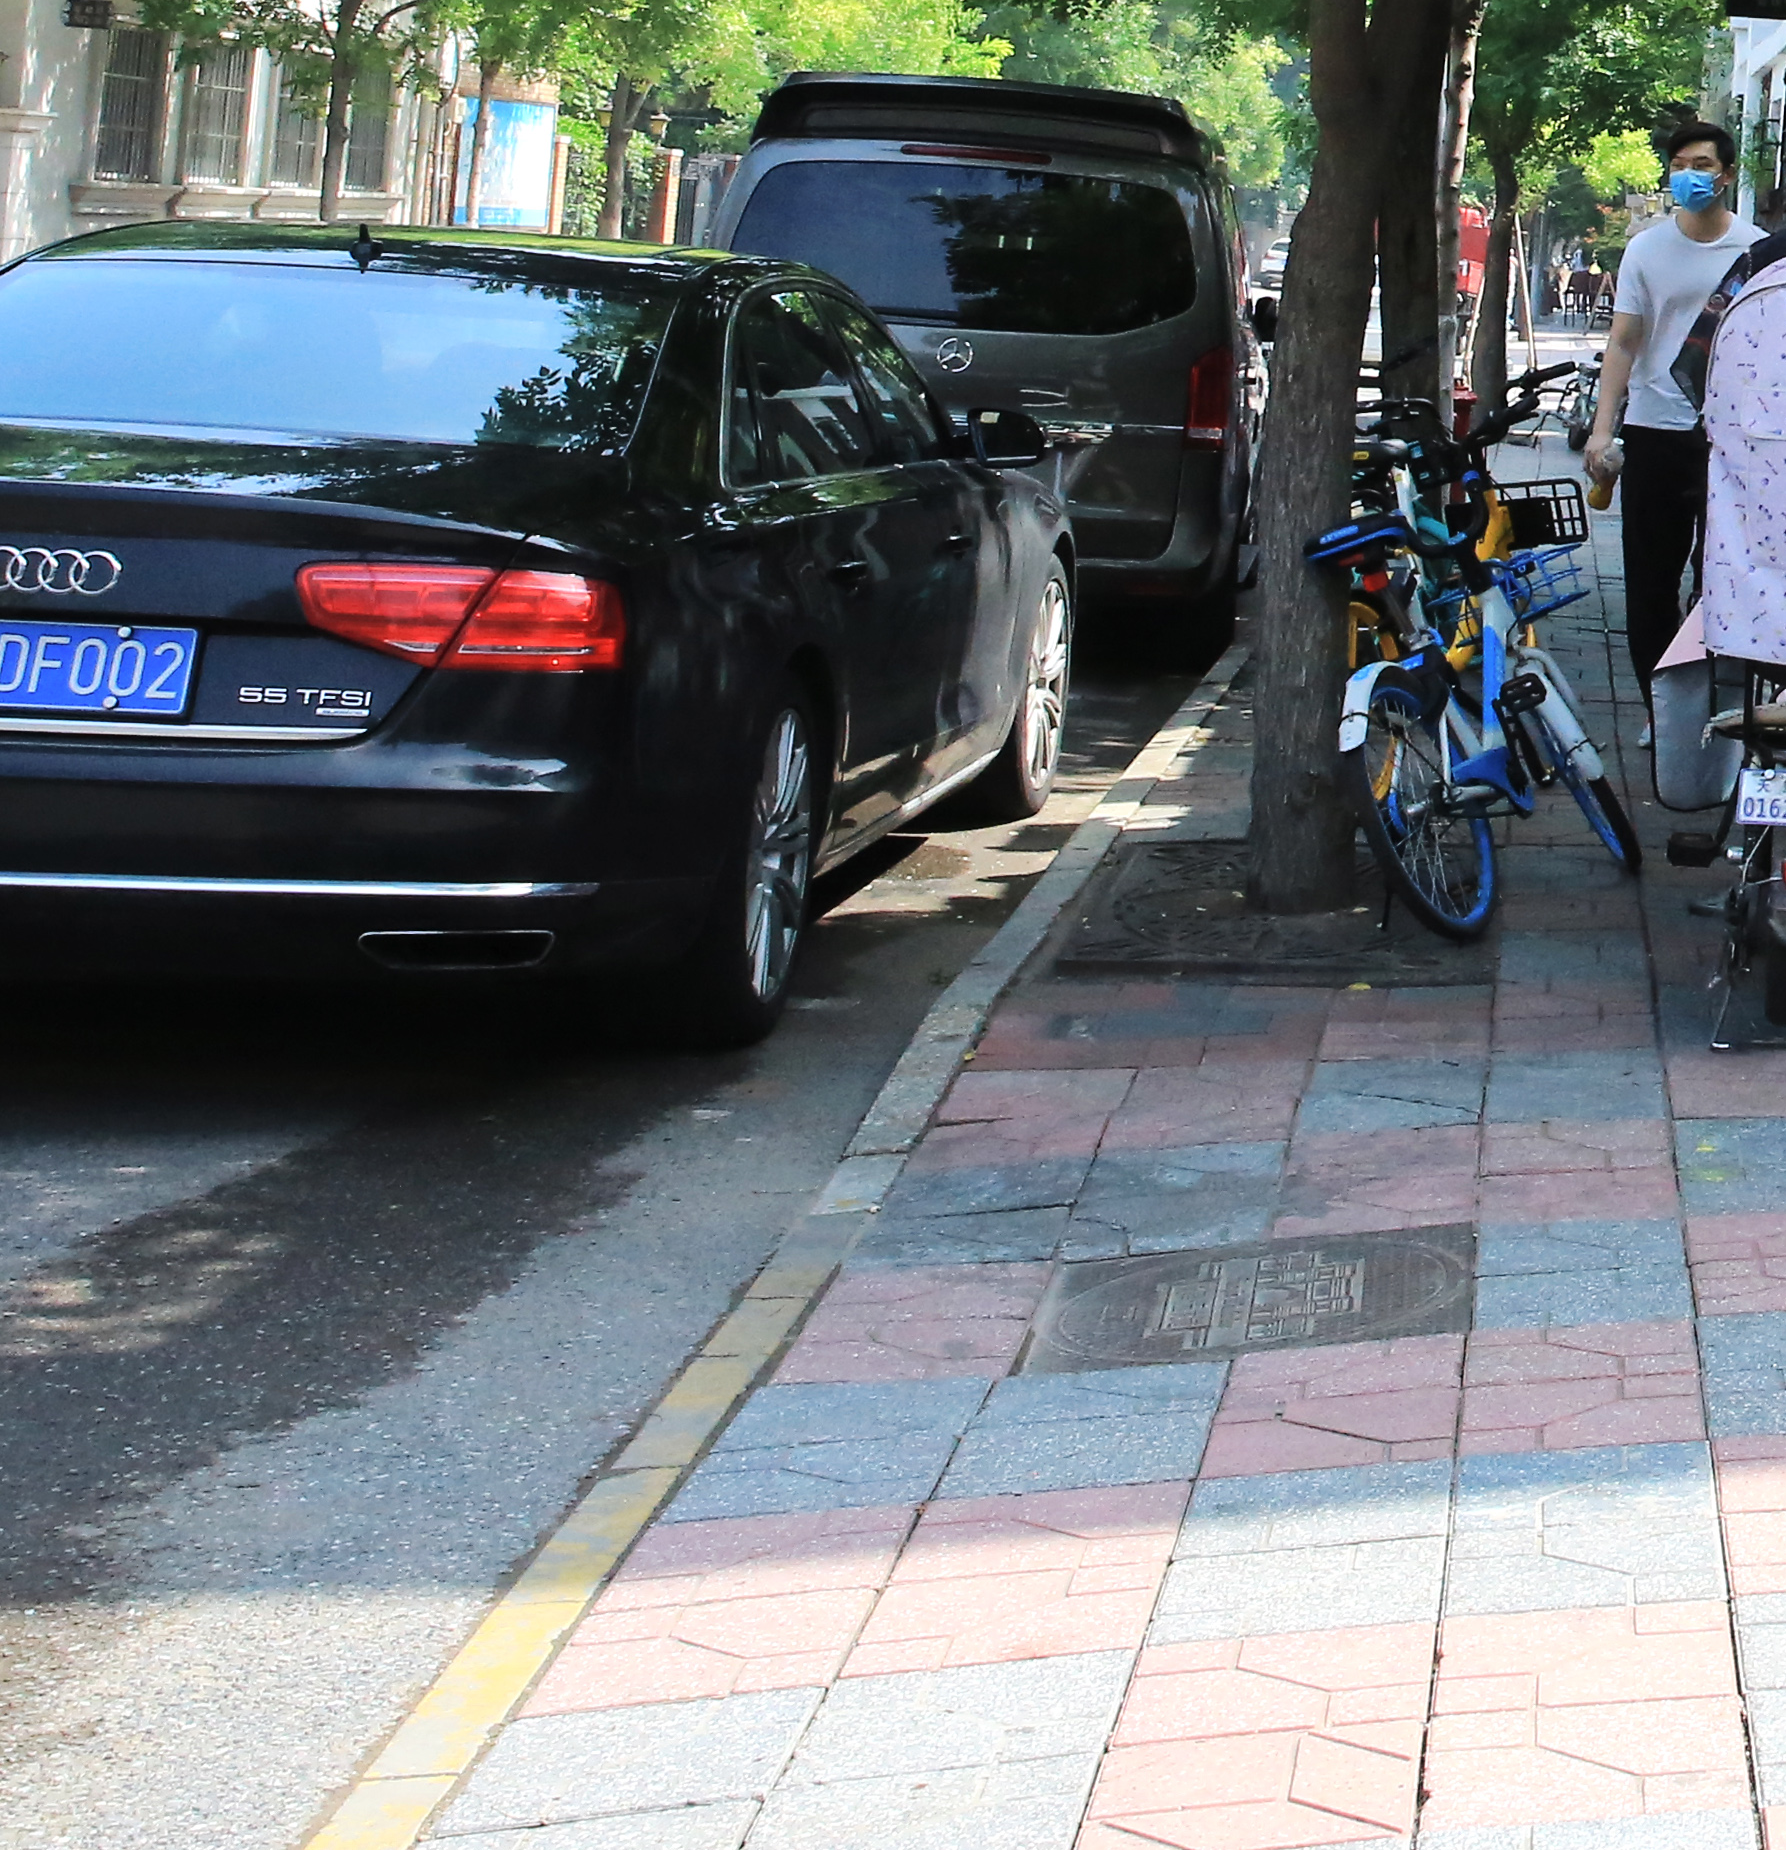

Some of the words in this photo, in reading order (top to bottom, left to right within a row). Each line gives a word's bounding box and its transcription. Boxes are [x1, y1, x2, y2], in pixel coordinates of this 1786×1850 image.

[0, 634, 187, 700] DF002
[238, 686, 288, 704] 55
[296, 688, 373, 707] TFSI
